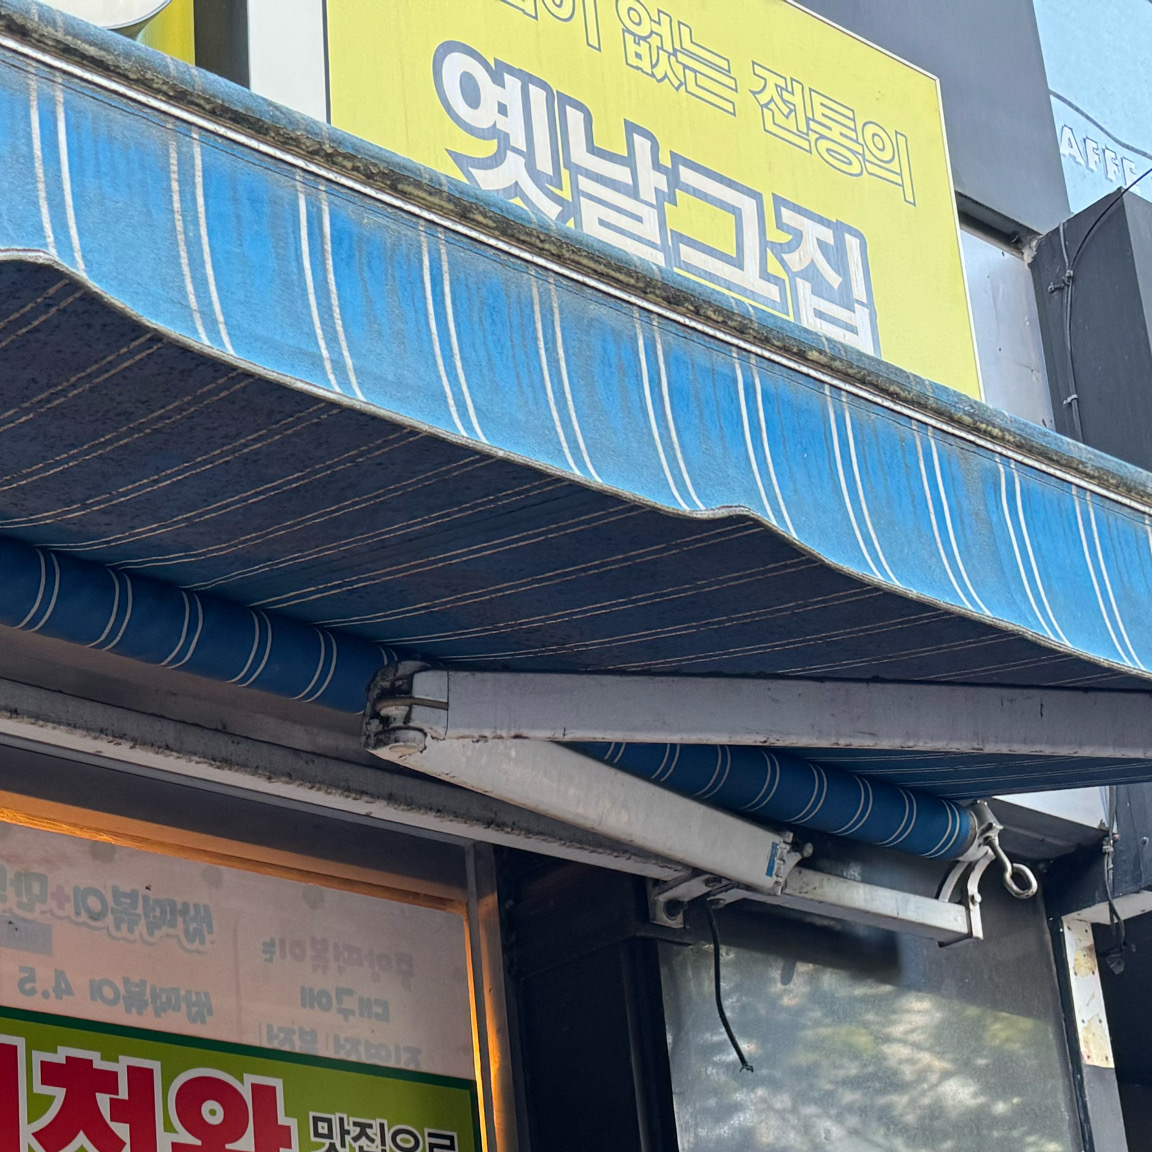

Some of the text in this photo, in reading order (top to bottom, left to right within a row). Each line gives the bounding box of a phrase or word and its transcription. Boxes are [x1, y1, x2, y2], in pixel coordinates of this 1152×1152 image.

[432, 40, 881, 357] 옛날그집
[615, 0, 738, 117] 없는
[748, 60, 917, 207] 전통의
